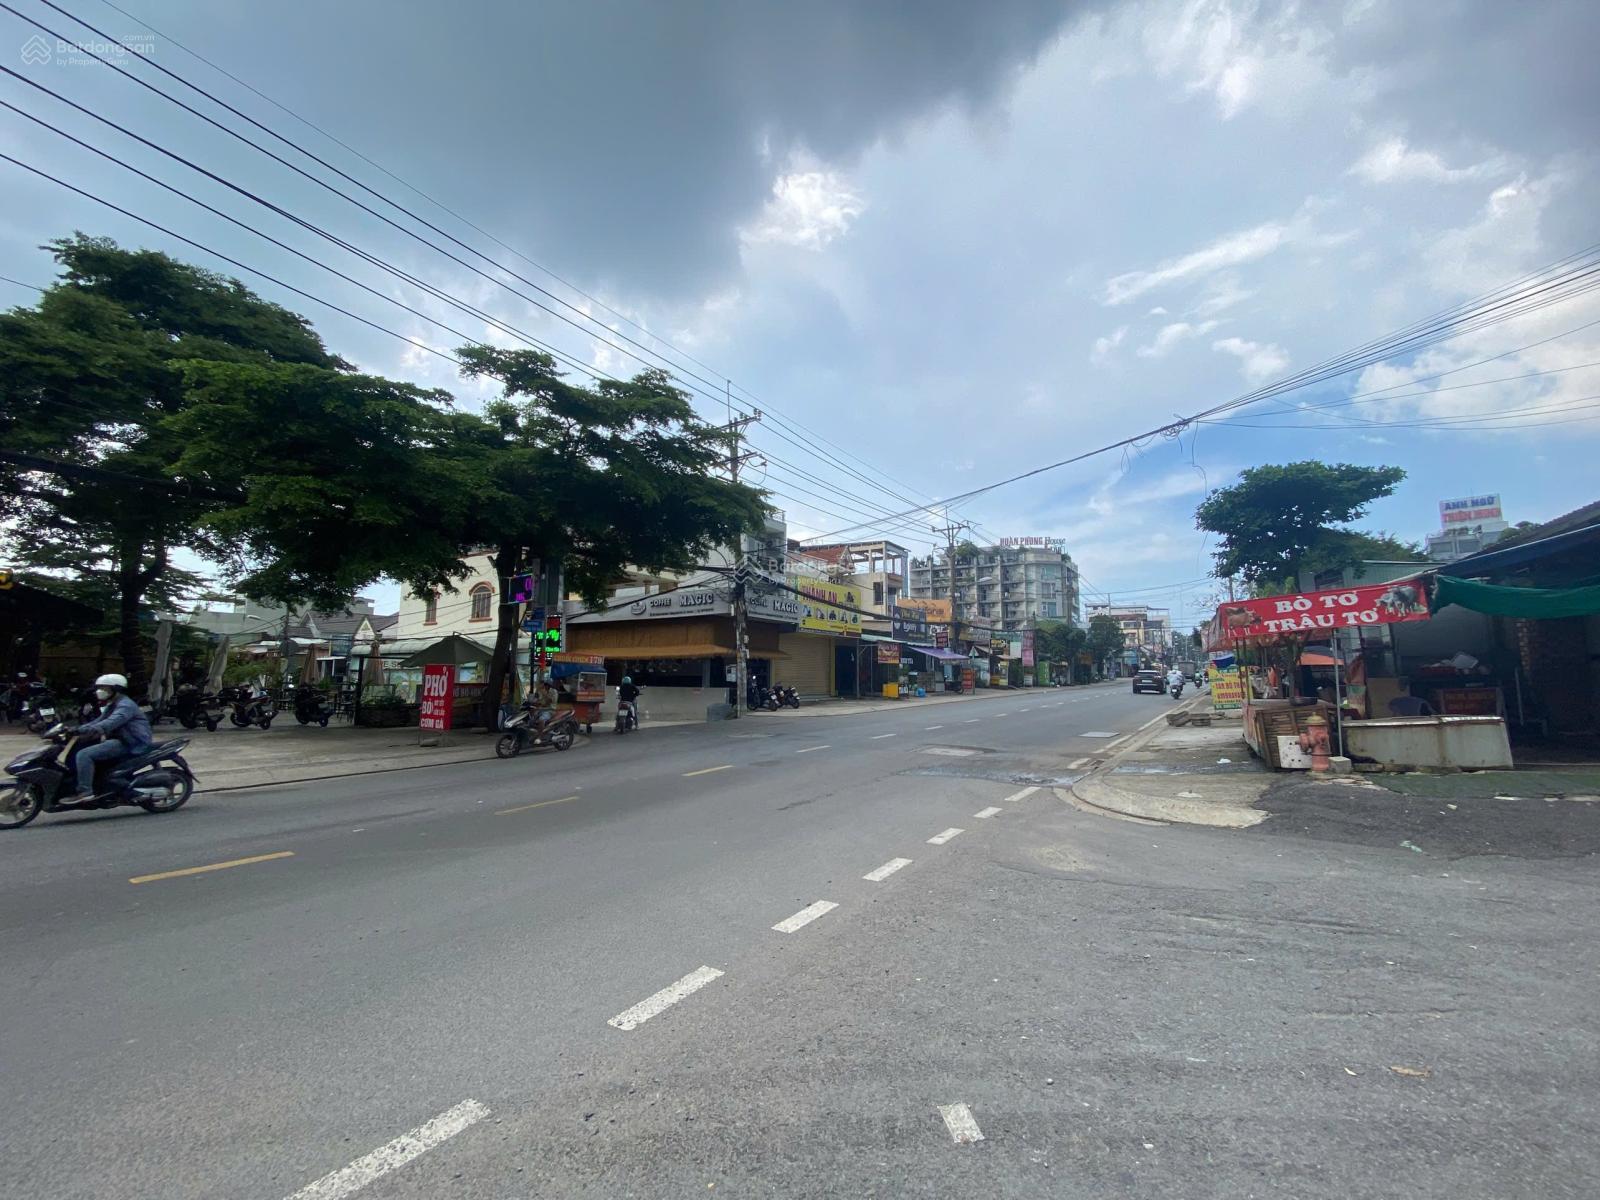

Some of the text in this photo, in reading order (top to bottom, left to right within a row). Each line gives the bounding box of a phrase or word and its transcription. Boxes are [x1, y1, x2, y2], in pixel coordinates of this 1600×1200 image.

[680, 593, 714, 606] MAGIC
[773, 599, 799, 613] MAGIC
[1274, 590, 1359, 613] BÒ TƠ
[1264, 607, 1379, 633] TRÂU TƠ
[423, 666, 449, 697] PHỞ
